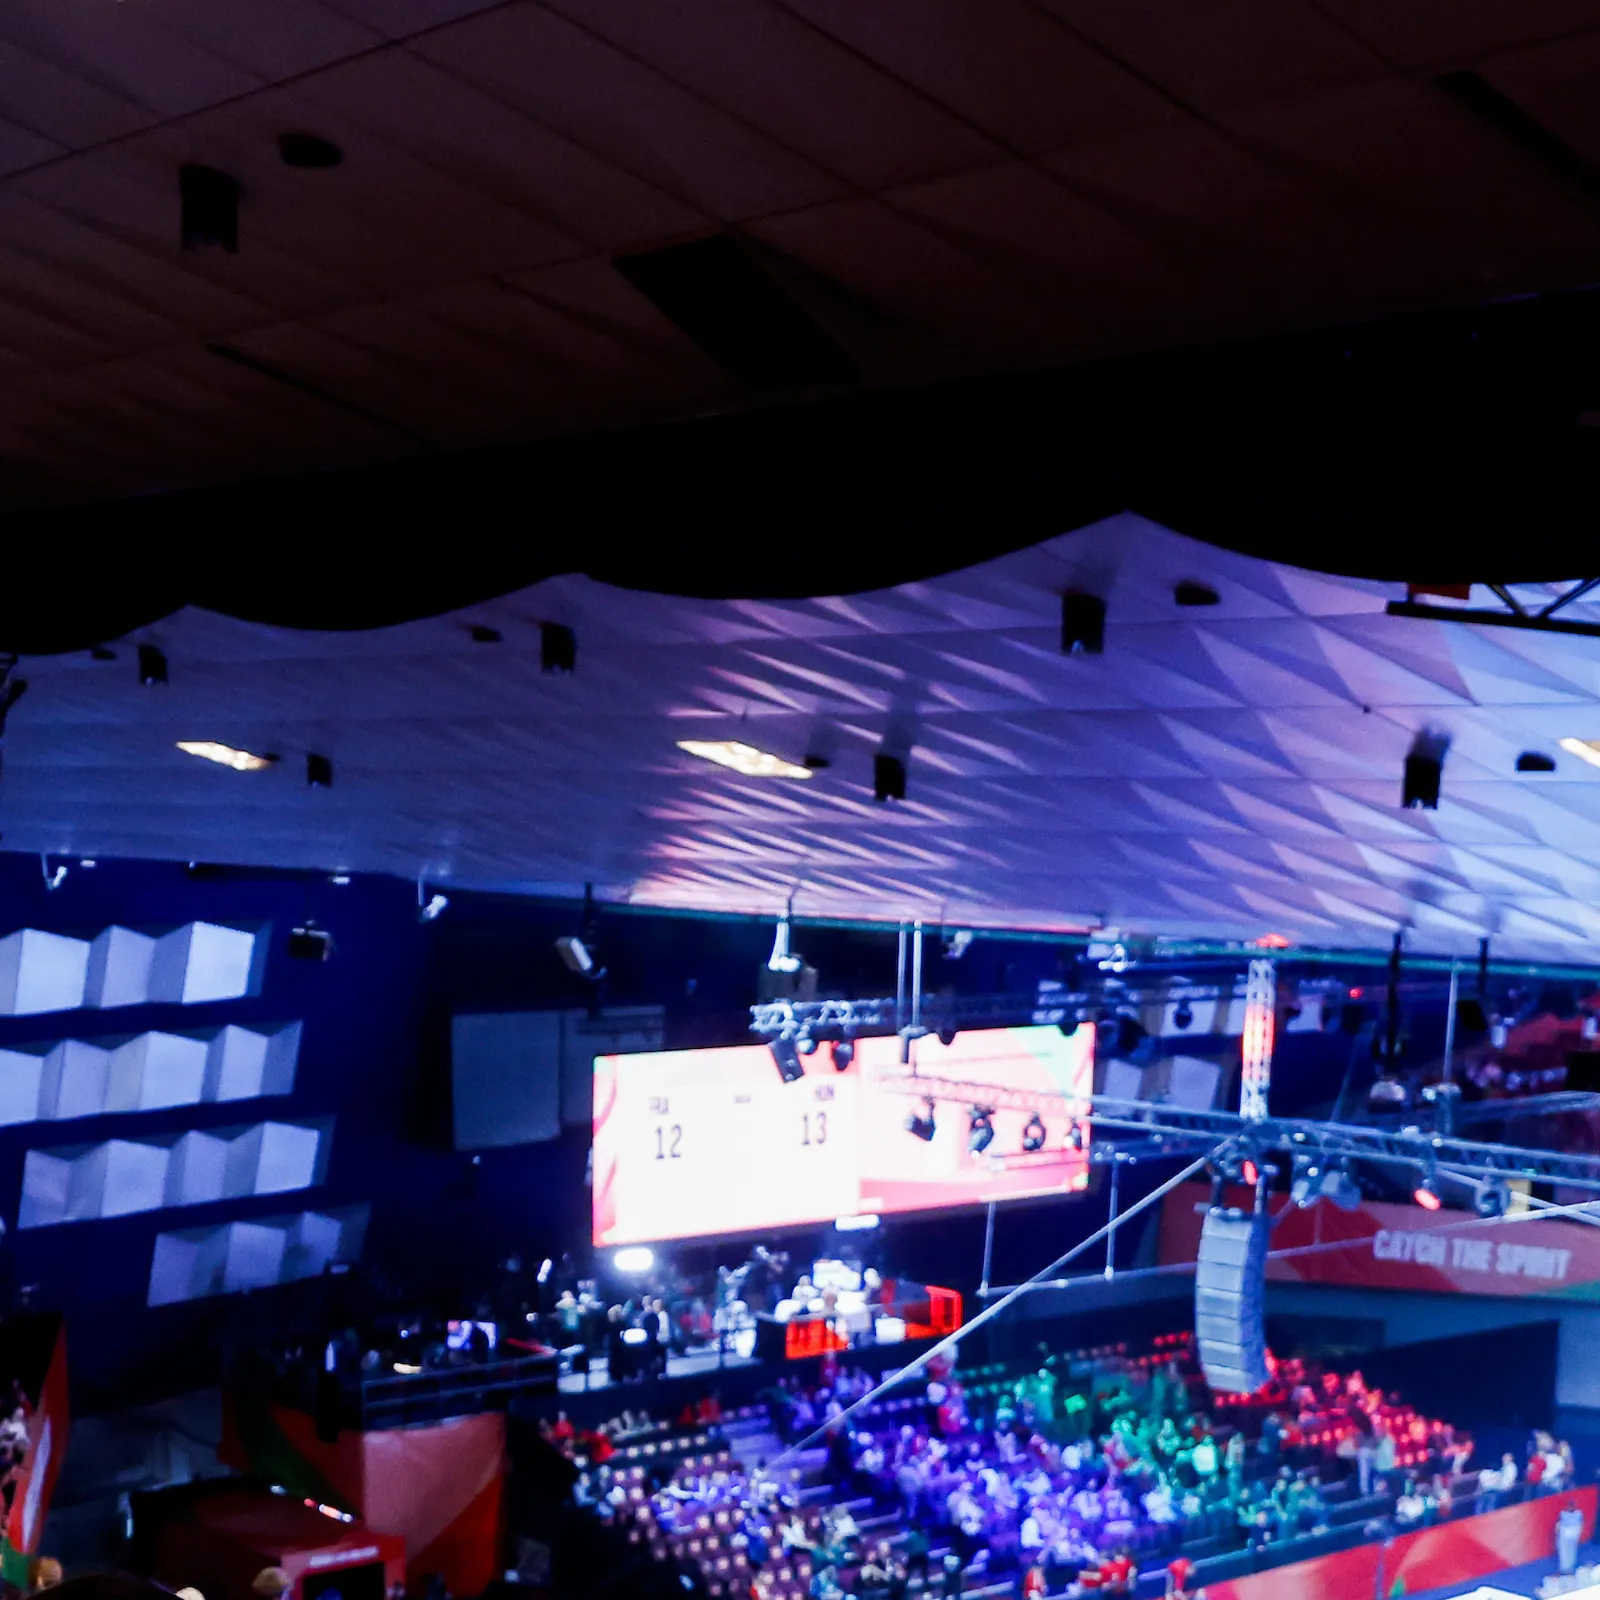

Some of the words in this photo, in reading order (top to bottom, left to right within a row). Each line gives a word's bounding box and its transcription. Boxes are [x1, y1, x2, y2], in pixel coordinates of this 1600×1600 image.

[656, 1125, 682, 1160] 12
[801, 1112, 827, 1145] 13
[1453, 1238, 1493, 1272] THE
